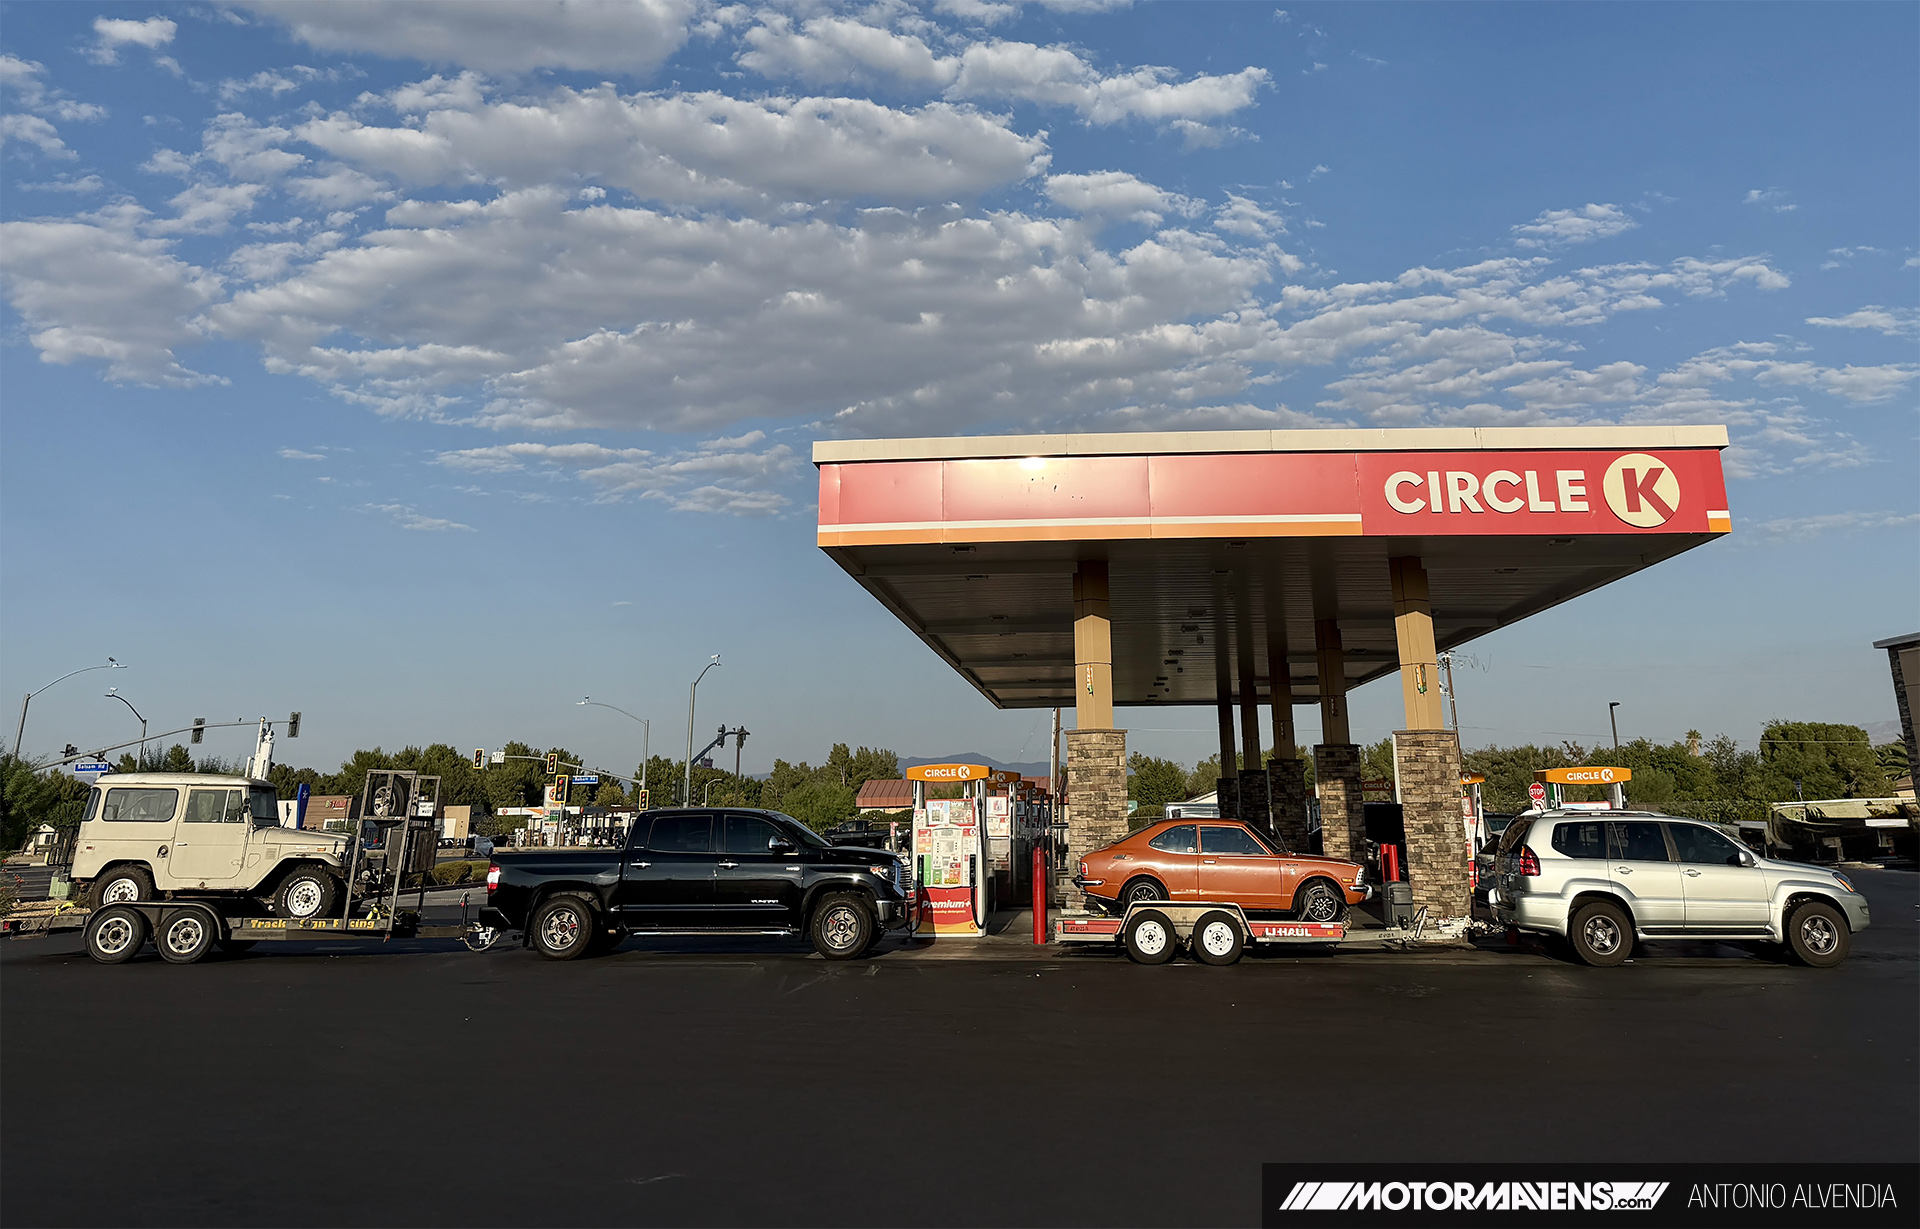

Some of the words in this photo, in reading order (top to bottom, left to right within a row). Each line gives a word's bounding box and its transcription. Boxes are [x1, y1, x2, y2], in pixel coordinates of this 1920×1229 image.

[1384, 469, 1590, 515] CIRCLE
[1619, 465, 1677, 523] K
[924, 768, 956, 778] CIRCLE
[960, 766, 970, 778] K
[1566, 771, 1600, 781] CIRCLE
[1602, 769, 1613, 781] K
[922, 898, 971, 909] Premium+
[250, 919, 287, 928] Track
[298, 919, 326, 930] Sgn
[1265, 927, 1312, 937] U-HAUL
